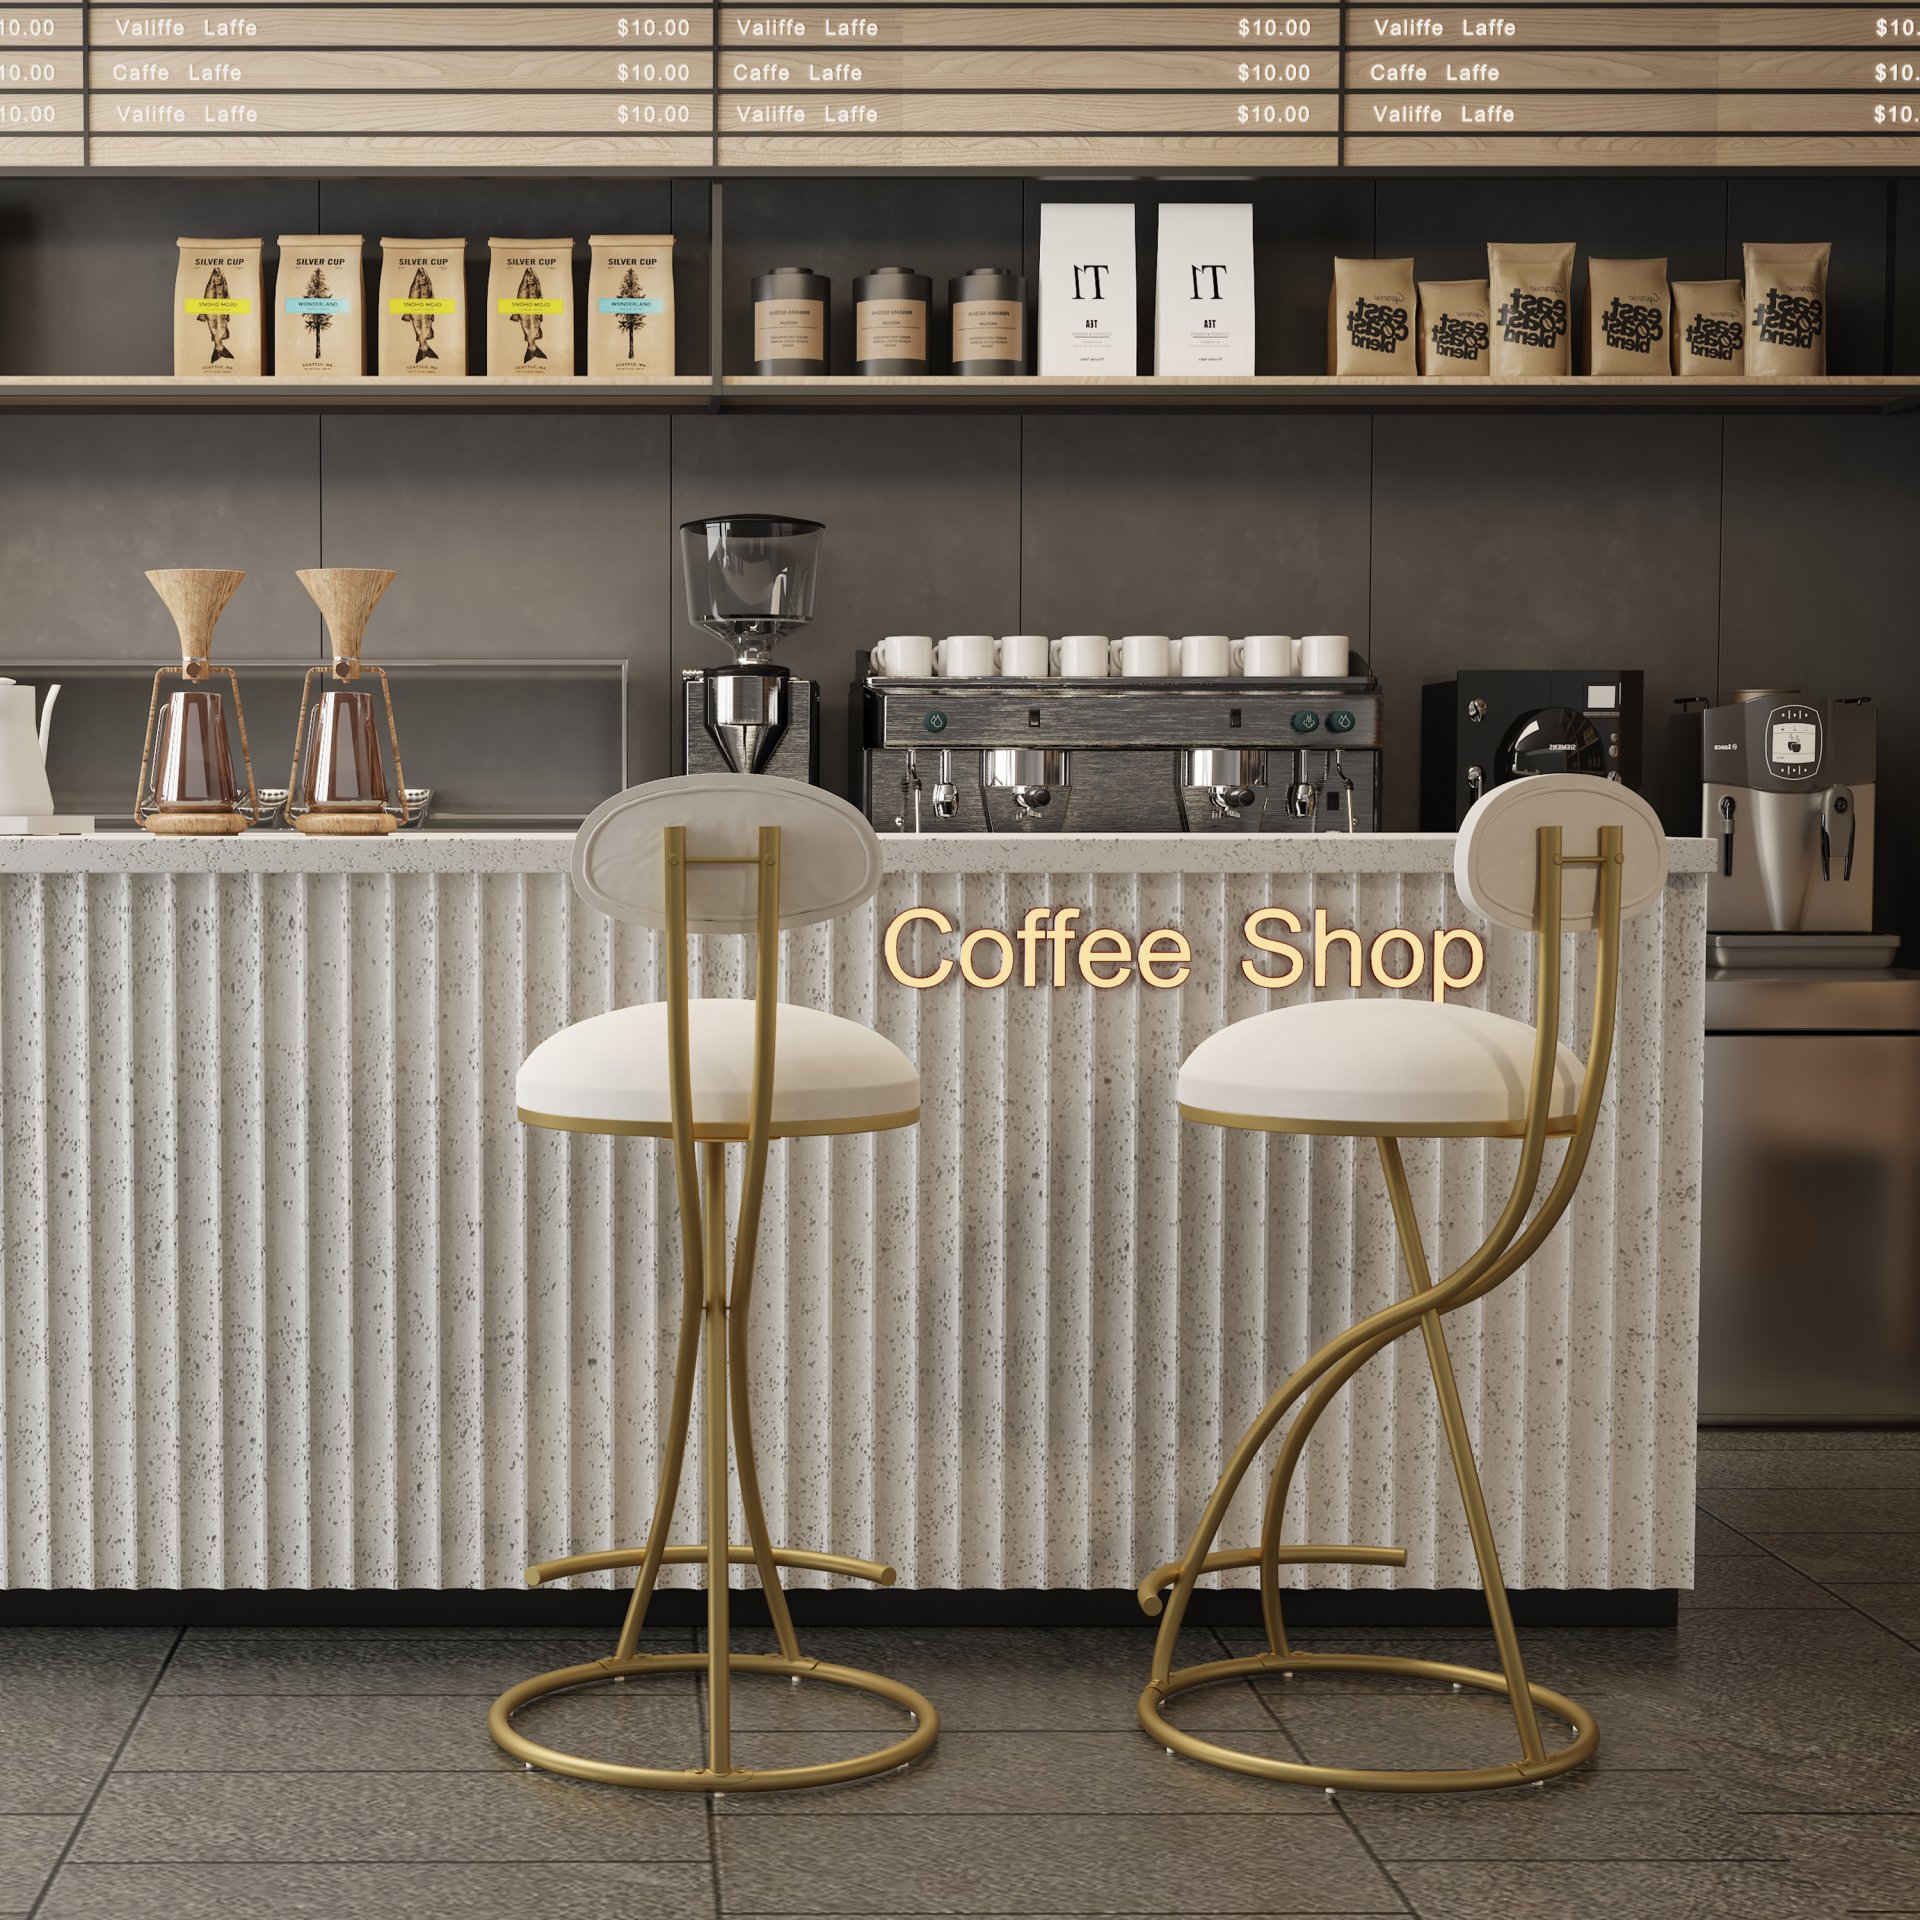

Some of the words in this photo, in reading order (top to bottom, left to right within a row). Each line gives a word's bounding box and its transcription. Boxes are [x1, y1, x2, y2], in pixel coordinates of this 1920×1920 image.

[115, 18, 185, 37] Valiffe
[204, 18, 258, 36] Laffe
[617, 18, 690, 38] $10.00
[736, 18, 806, 37] Valiffe
[825, 18, 879, 37] Laffe
[1238, 17, 1311, 38] $10.00
[1373, 18, 1444, 37] Valiffe
[1462, 18, 1516, 37] Laffe
[112, 63, 169, 81] Caffe
[189, 63, 242, 81] Laffe
[617, 63, 690, 83] $10.00
[733, 63, 790, 82] Caffe
[809, 63, 863, 82] Laffe
[1238, 62, 1310, 83] $10.00
[1369, 63, 1428, 82] Caffe
[1446, 63, 1500, 82] Laffe
[116, 104, 185, 122] Valiffe
[205, 104, 258, 122] Laffe
[617, 104, 690, 124] $10.00
[736, 105, 806, 123] Valiffe
[824, 105, 878, 123] Laffe
[1237, 104, 1310, 124] $10.00
[1372, 104, 1443, 123] Valiffe
[1461, 104, 1515, 123] Laffe
[195, 258, 224, 266] SILVER
[227, 258, 245, 266] CUP
[296, 258, 325, 266] SILVER
[327, 258, 345, 266] CUP
[399, 258, 428, 266] SILVER
[430, 258, 448, 266] CUP
[507, 258, 536, 266] SILVER
[538, 258, 557, 266] CUP
[608, 258, 637, 266] SILVER
[639, 258, 657, 266] CUP
[884, 907, 1192, 989] Coffee
[1241, 907, 1485, 1003] Shop
